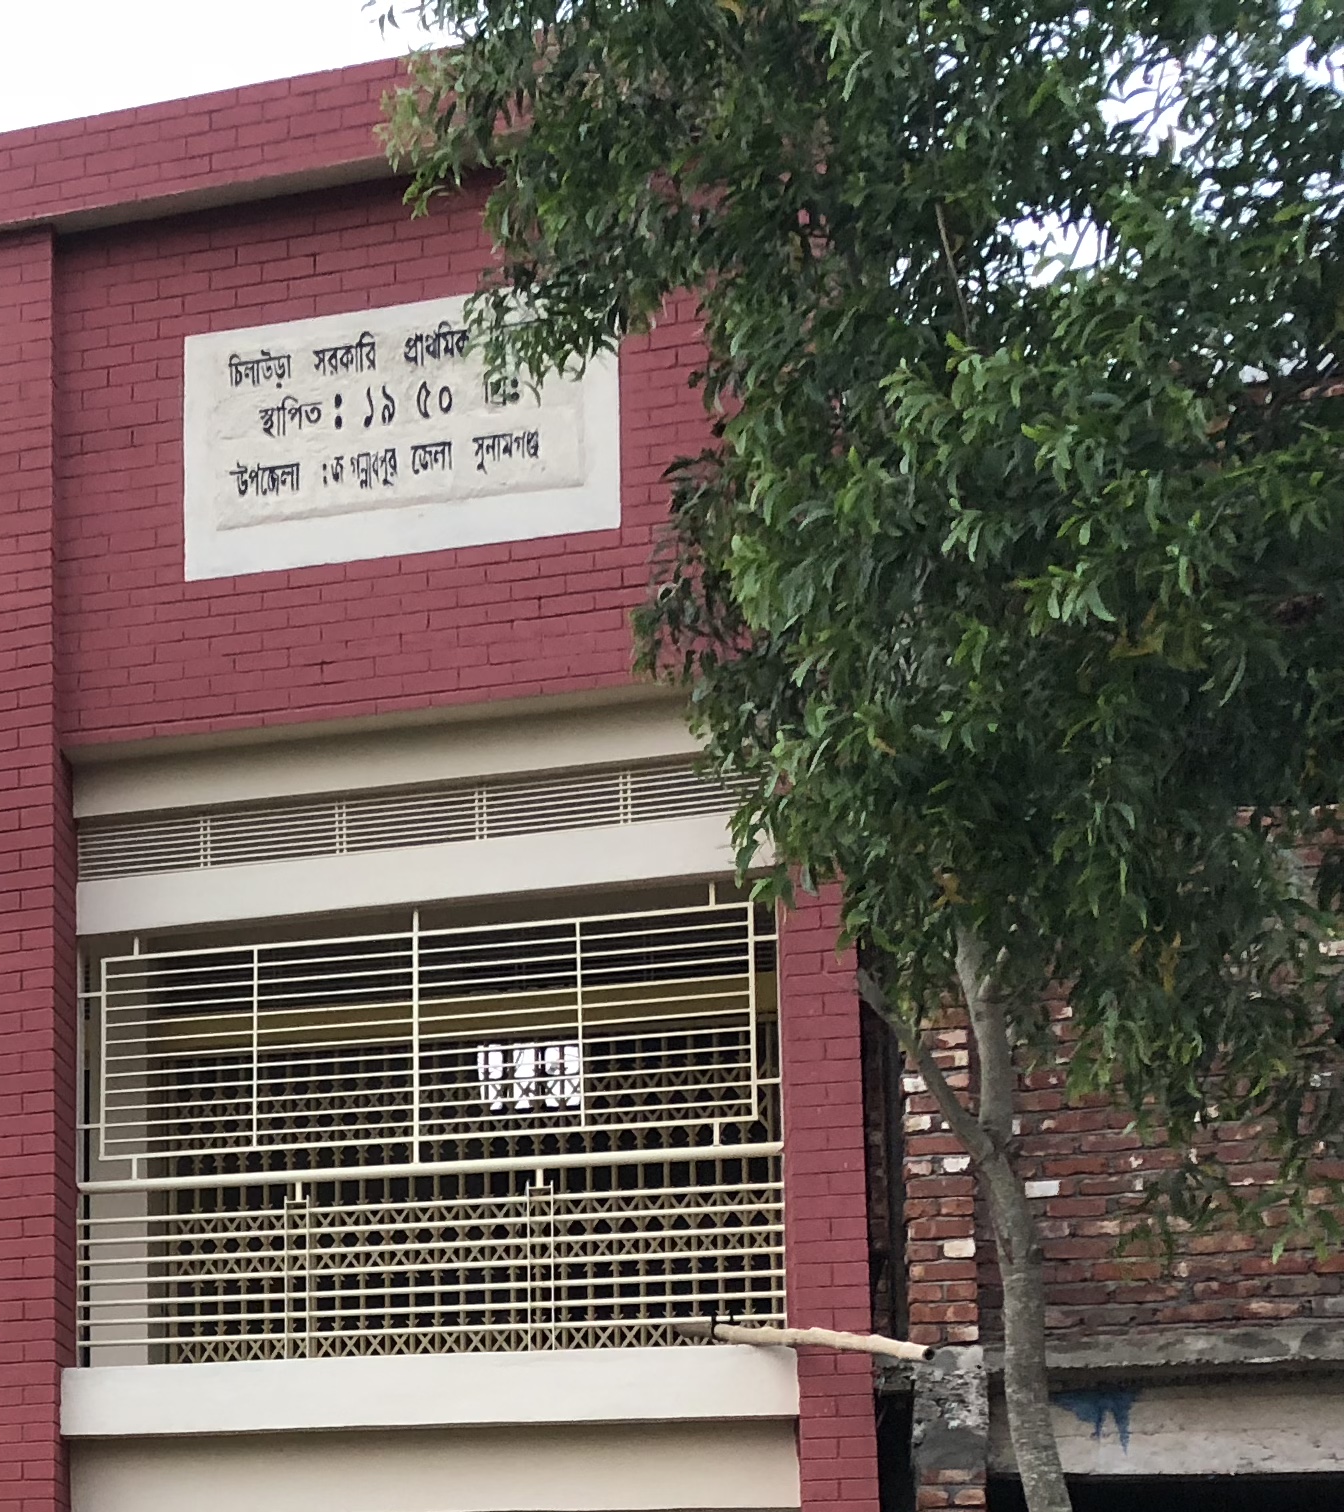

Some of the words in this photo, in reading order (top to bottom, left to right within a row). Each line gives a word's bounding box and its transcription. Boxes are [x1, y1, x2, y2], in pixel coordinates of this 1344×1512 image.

[228, 350, 291, 388] চিলাউড়া
[313, 331, 376, 376] সরকারি
[403, 320, 469, 367] প্রাথমিক
[259, 395, 322, 438] স্থাপিত
[228, 458, 300, 496] উপজেলা
[410, 441, 453, 475] জেলা
